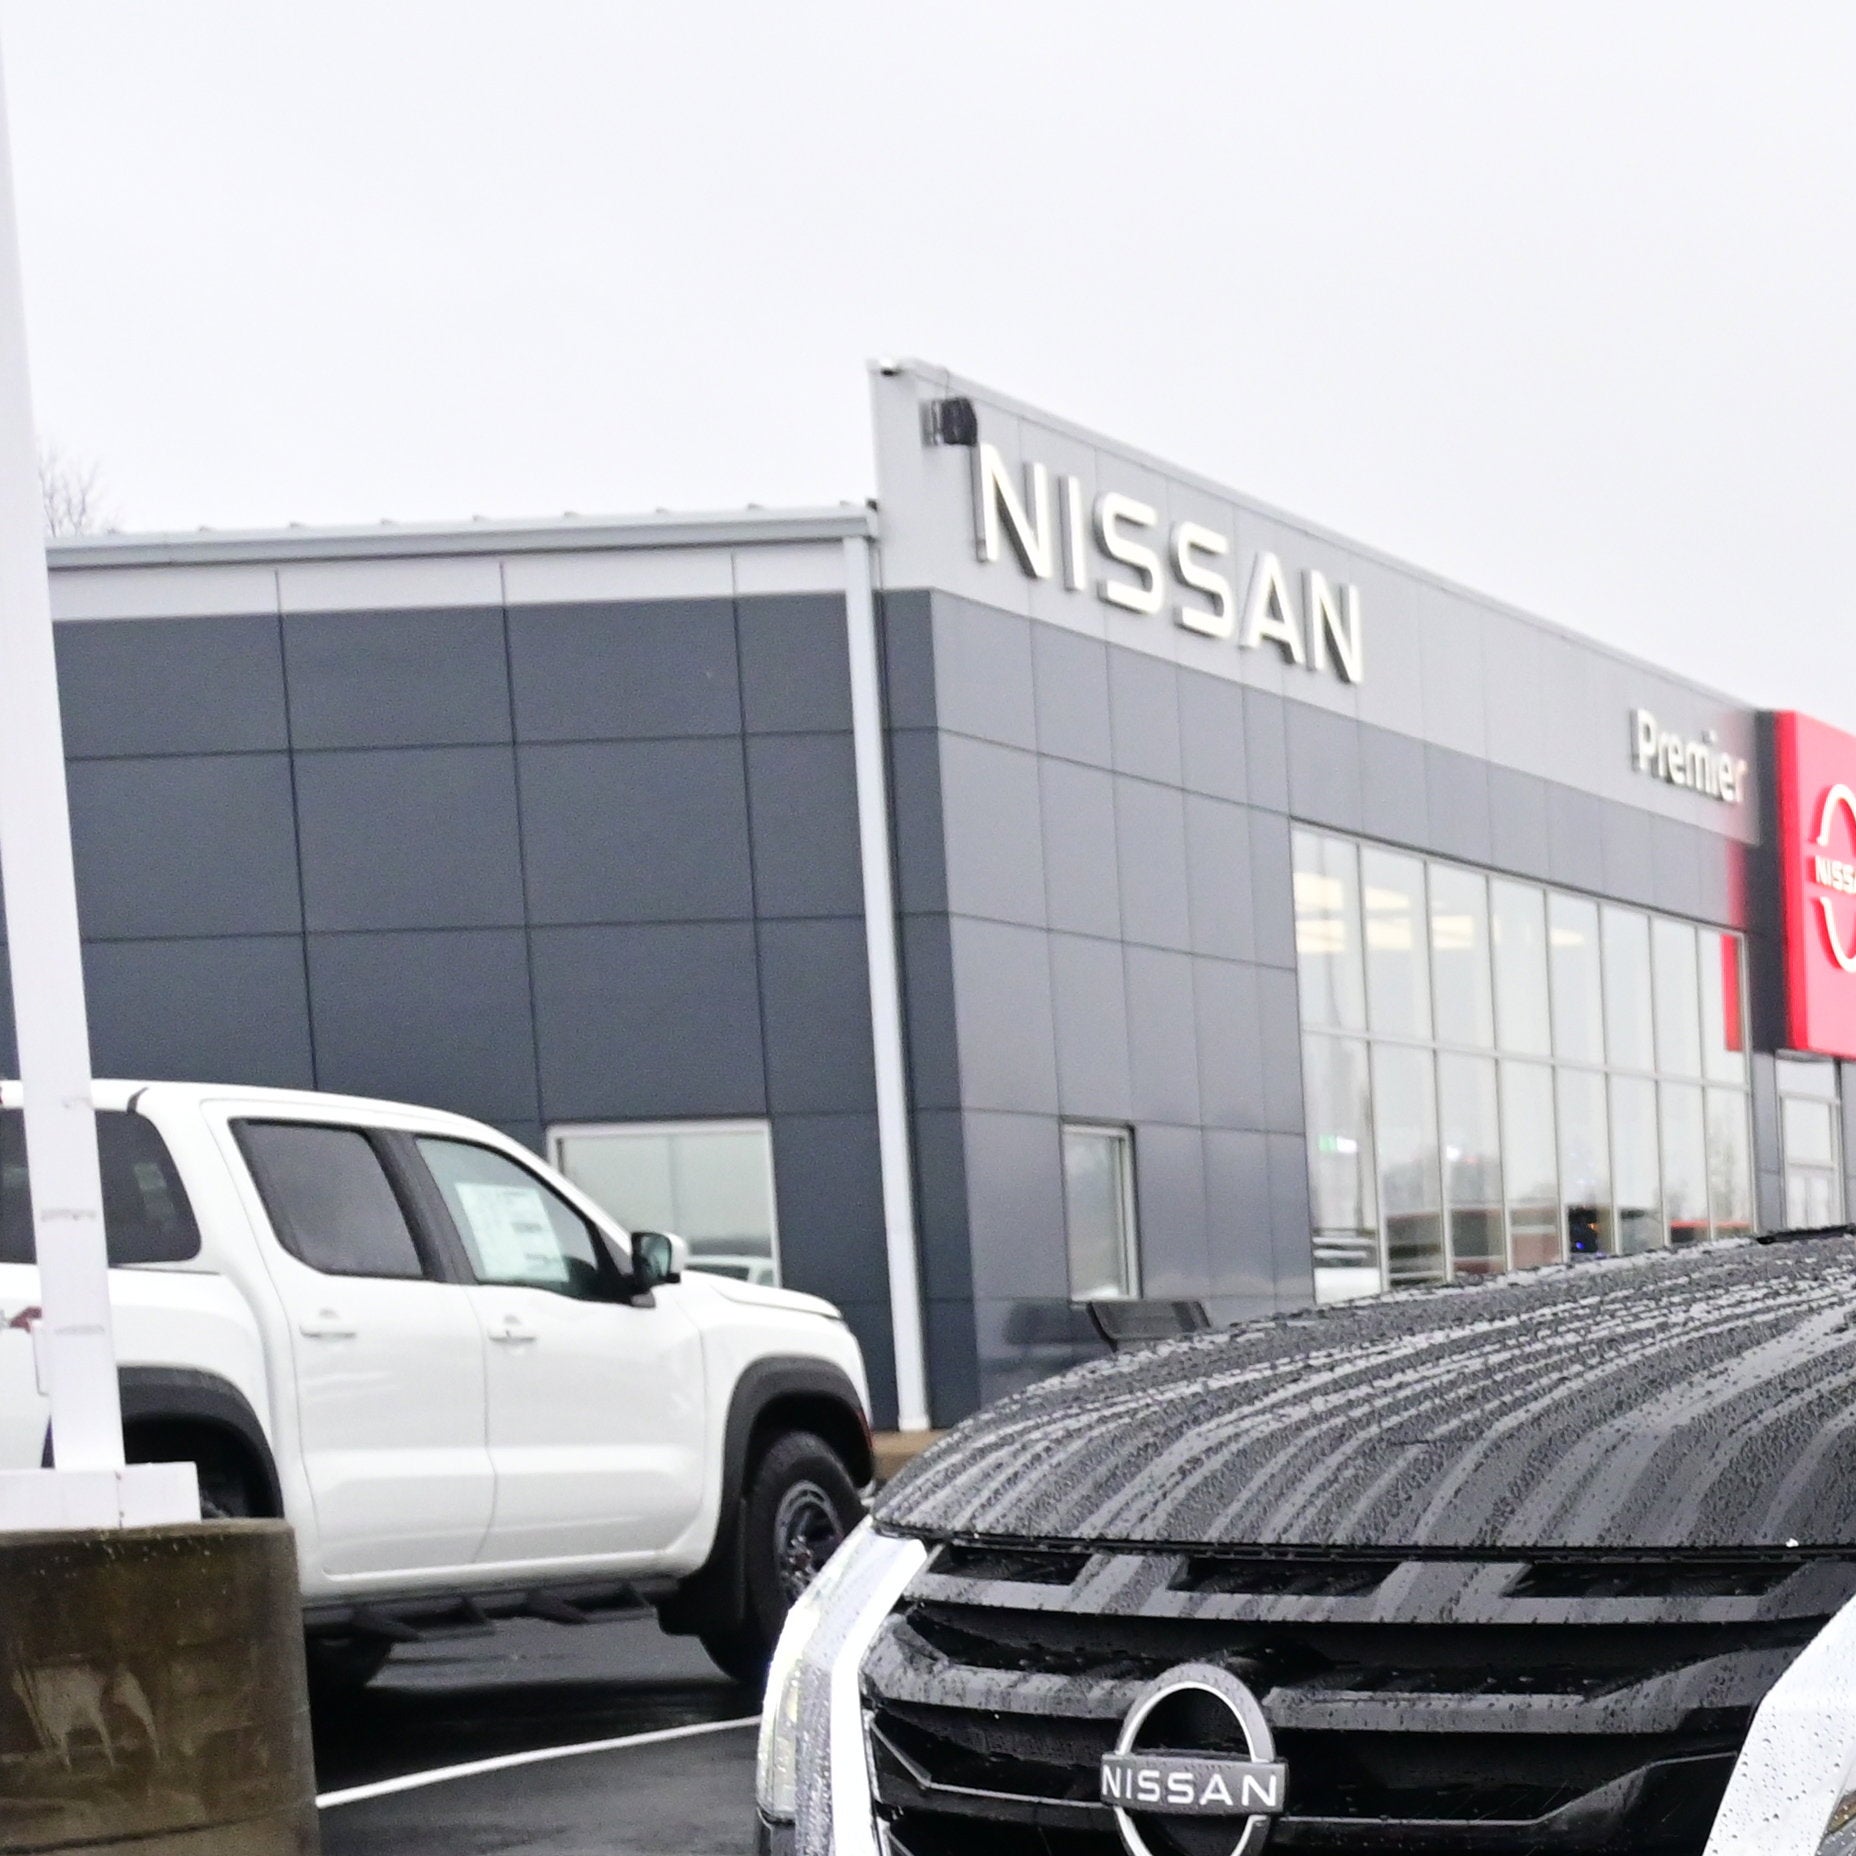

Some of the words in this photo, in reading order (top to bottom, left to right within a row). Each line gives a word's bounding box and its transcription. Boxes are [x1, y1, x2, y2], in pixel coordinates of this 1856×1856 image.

[971, 441, 1363, 685] NISSAN
[1630, 708, 1748, 804] Premier
[1102, 1764, 1278, 1807] NISSAN
